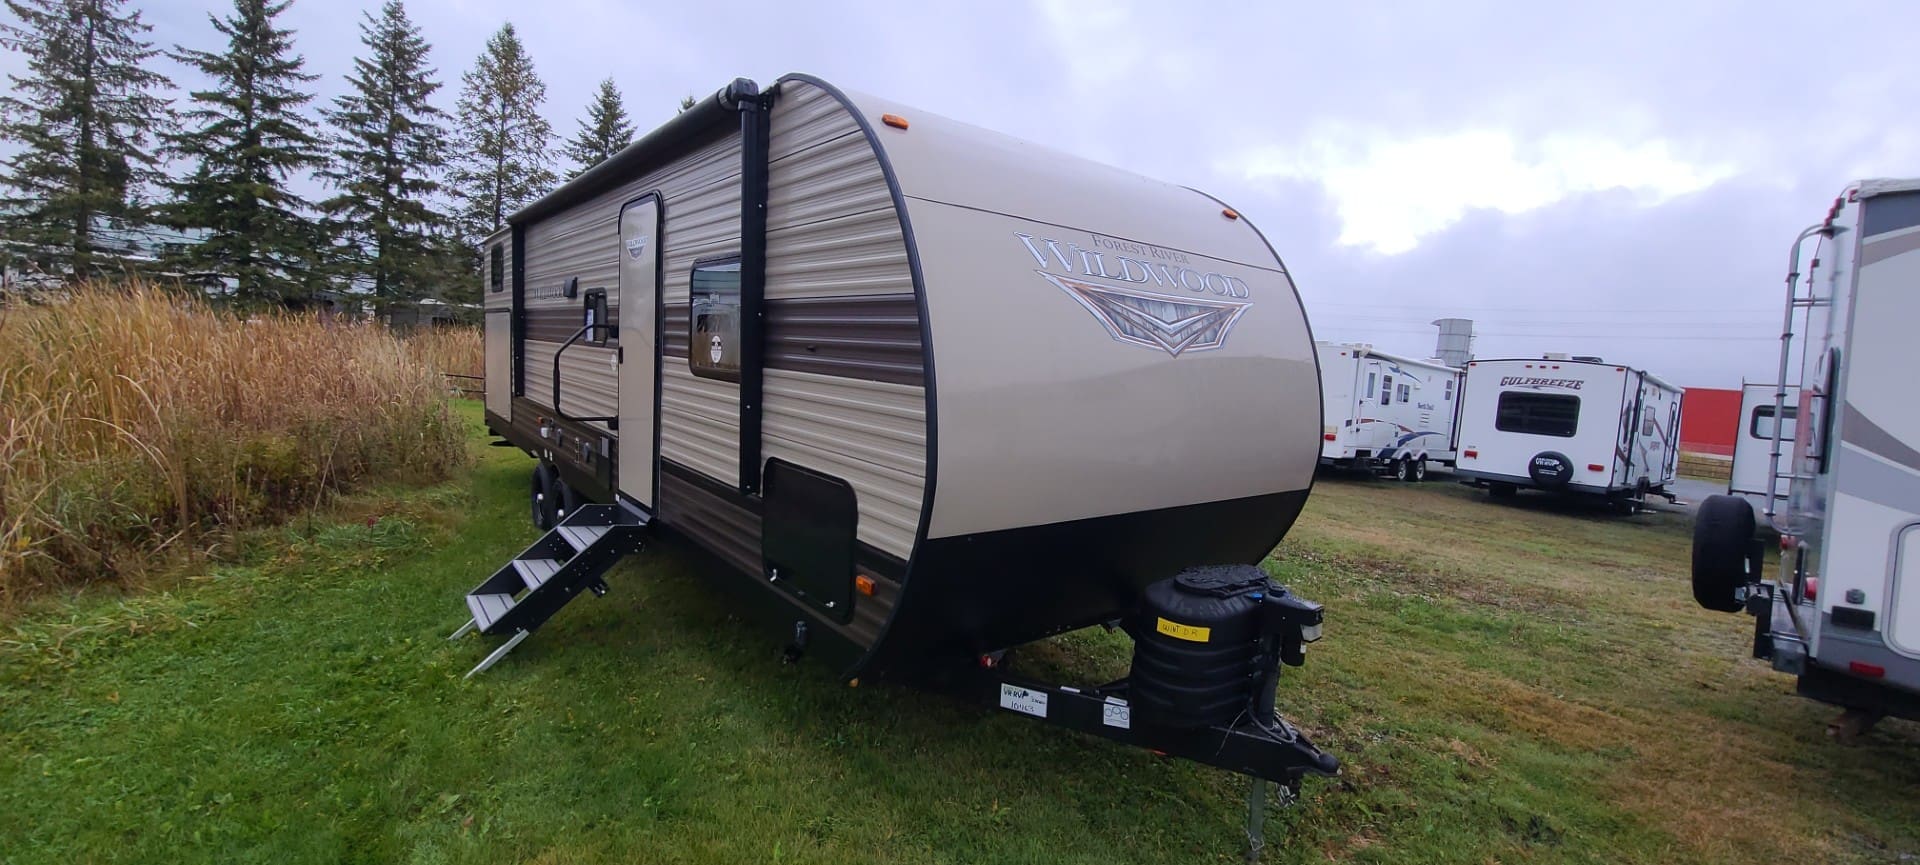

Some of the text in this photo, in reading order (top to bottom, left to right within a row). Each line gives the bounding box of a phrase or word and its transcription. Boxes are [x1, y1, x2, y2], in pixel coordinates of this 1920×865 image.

[1013, 231, 1251, 299] WILDWOOD
[1148, 245, 1190, 265] RIVER
[1500, 376, 1585, 391] GULFBREEZE
